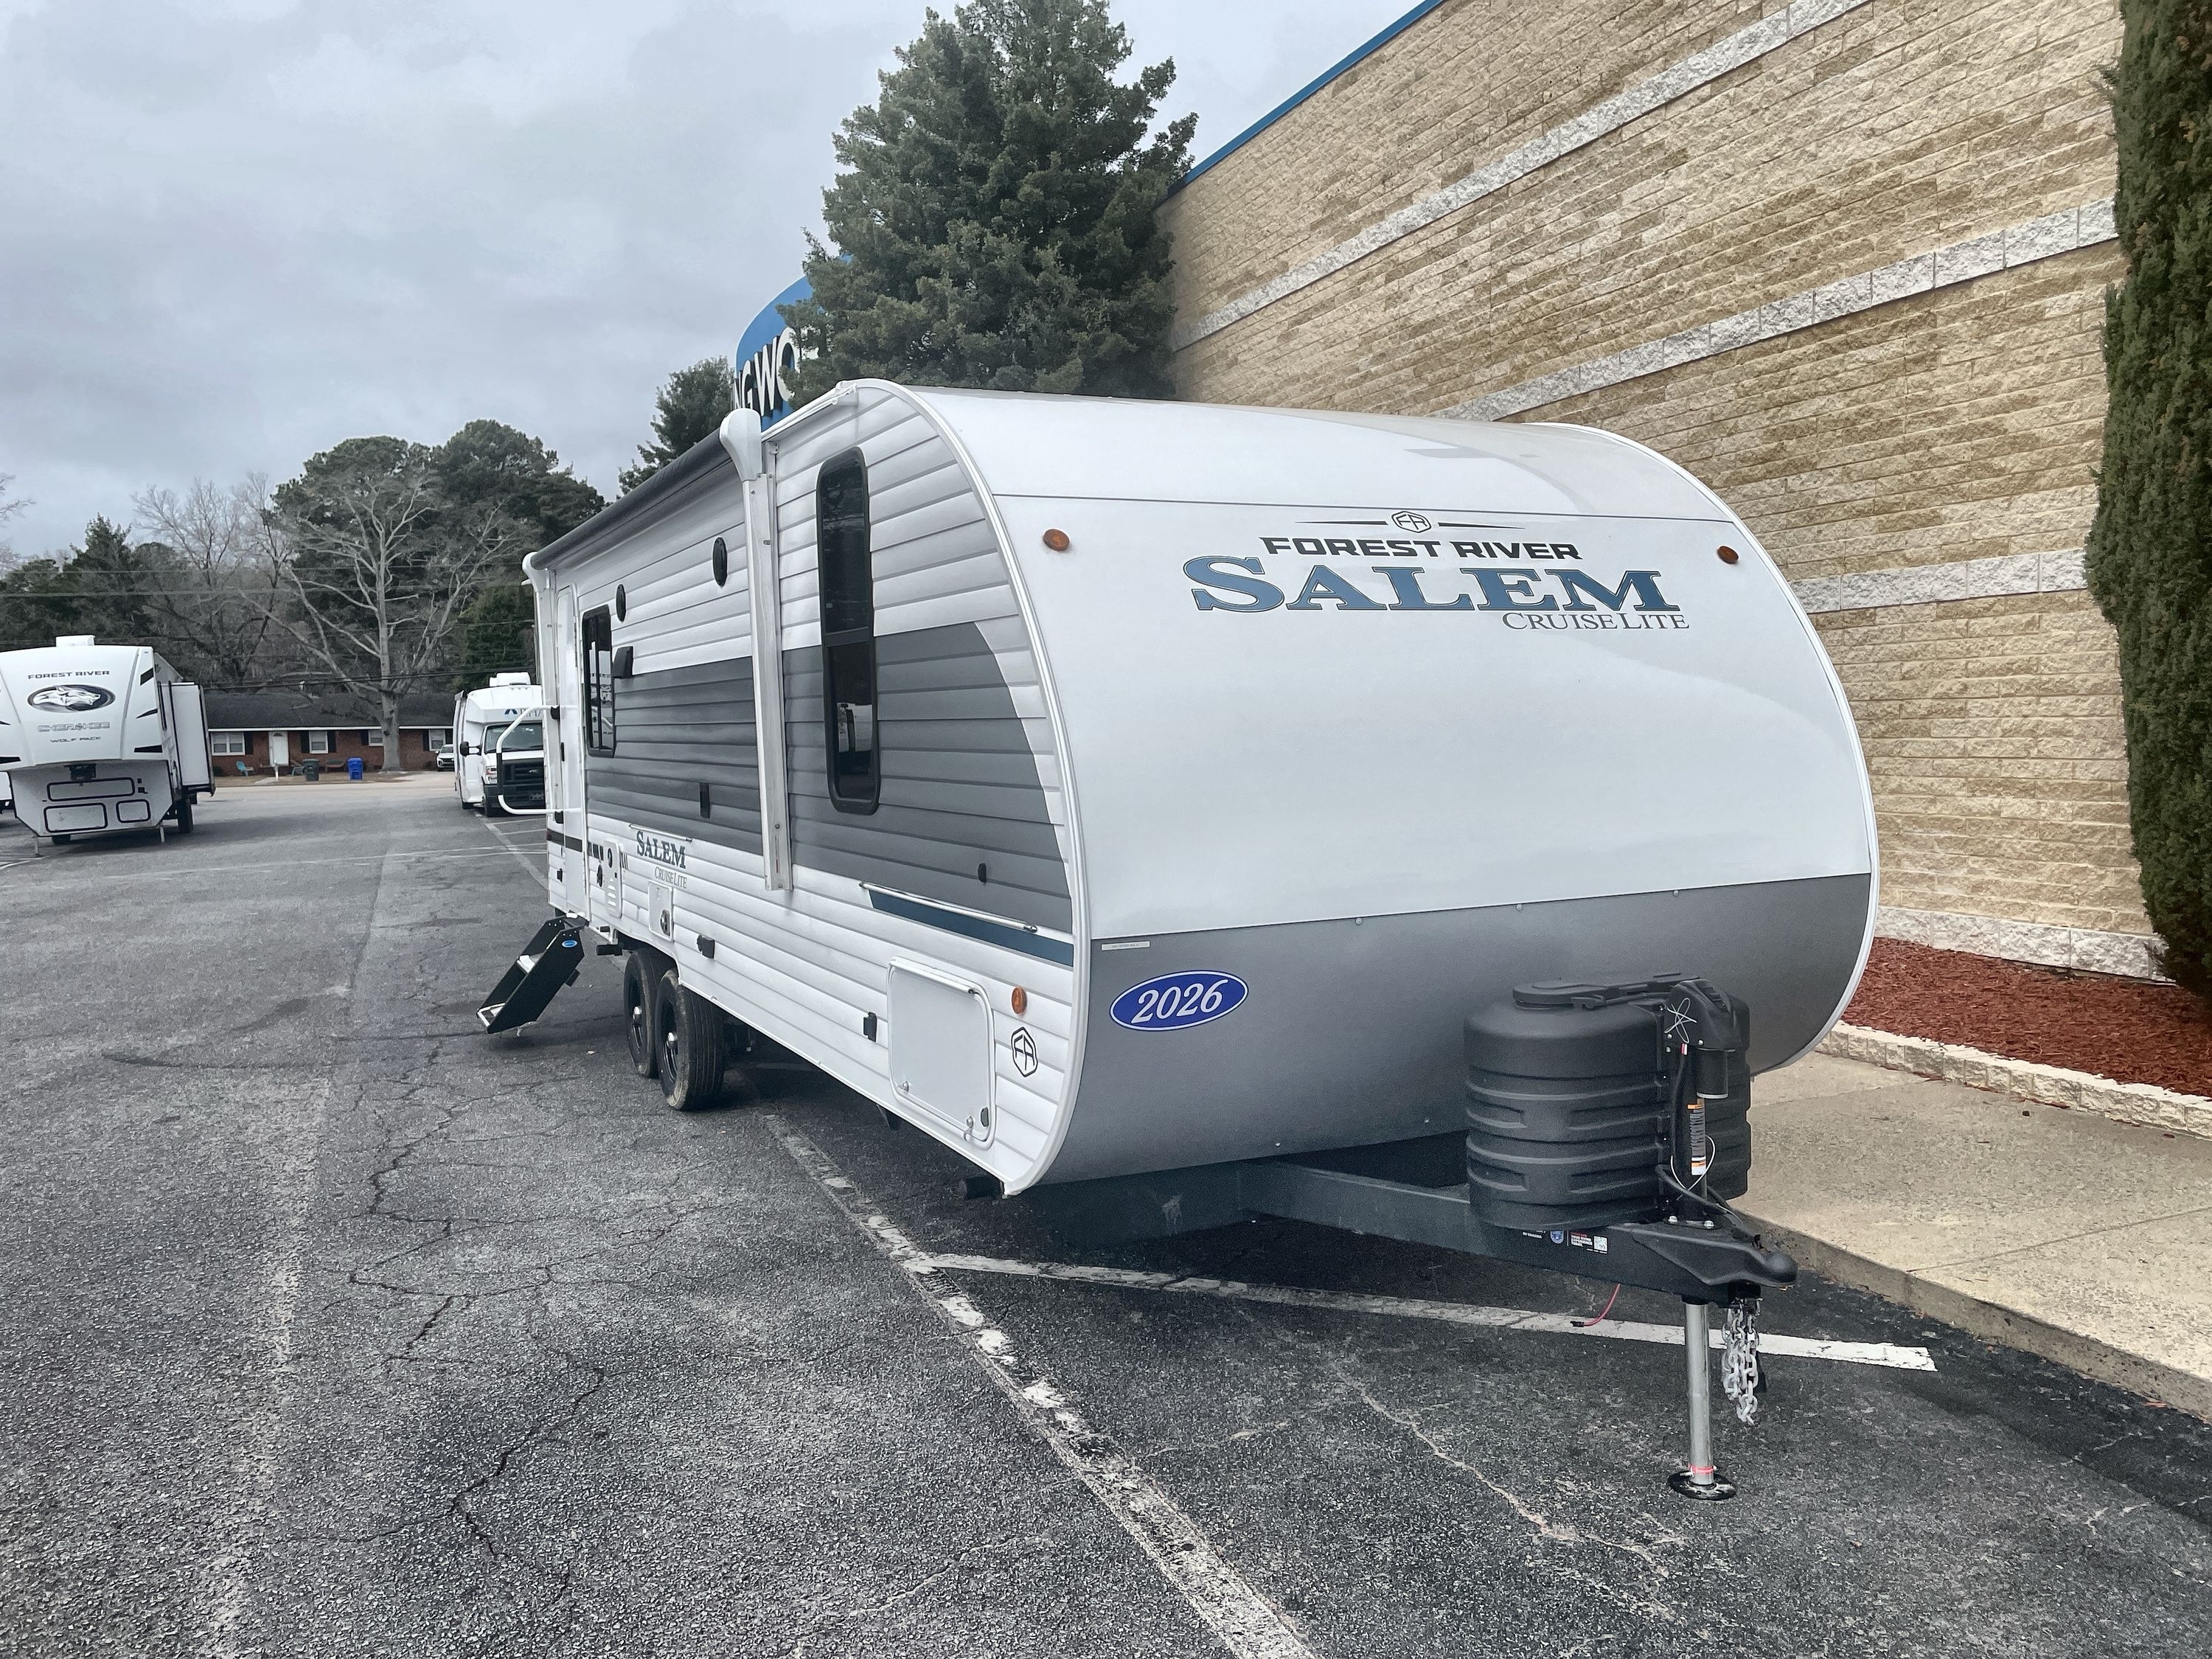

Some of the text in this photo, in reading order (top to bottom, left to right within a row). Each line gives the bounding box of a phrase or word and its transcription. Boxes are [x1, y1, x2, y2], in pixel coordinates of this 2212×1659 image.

[1258, 537, 1583, 560] FOREST RIVER
[1183, 555, 1680, 613] SALEM
[636, 830, 686, 869] SALEM
[1130, 978, 1229, 1024] 2026
